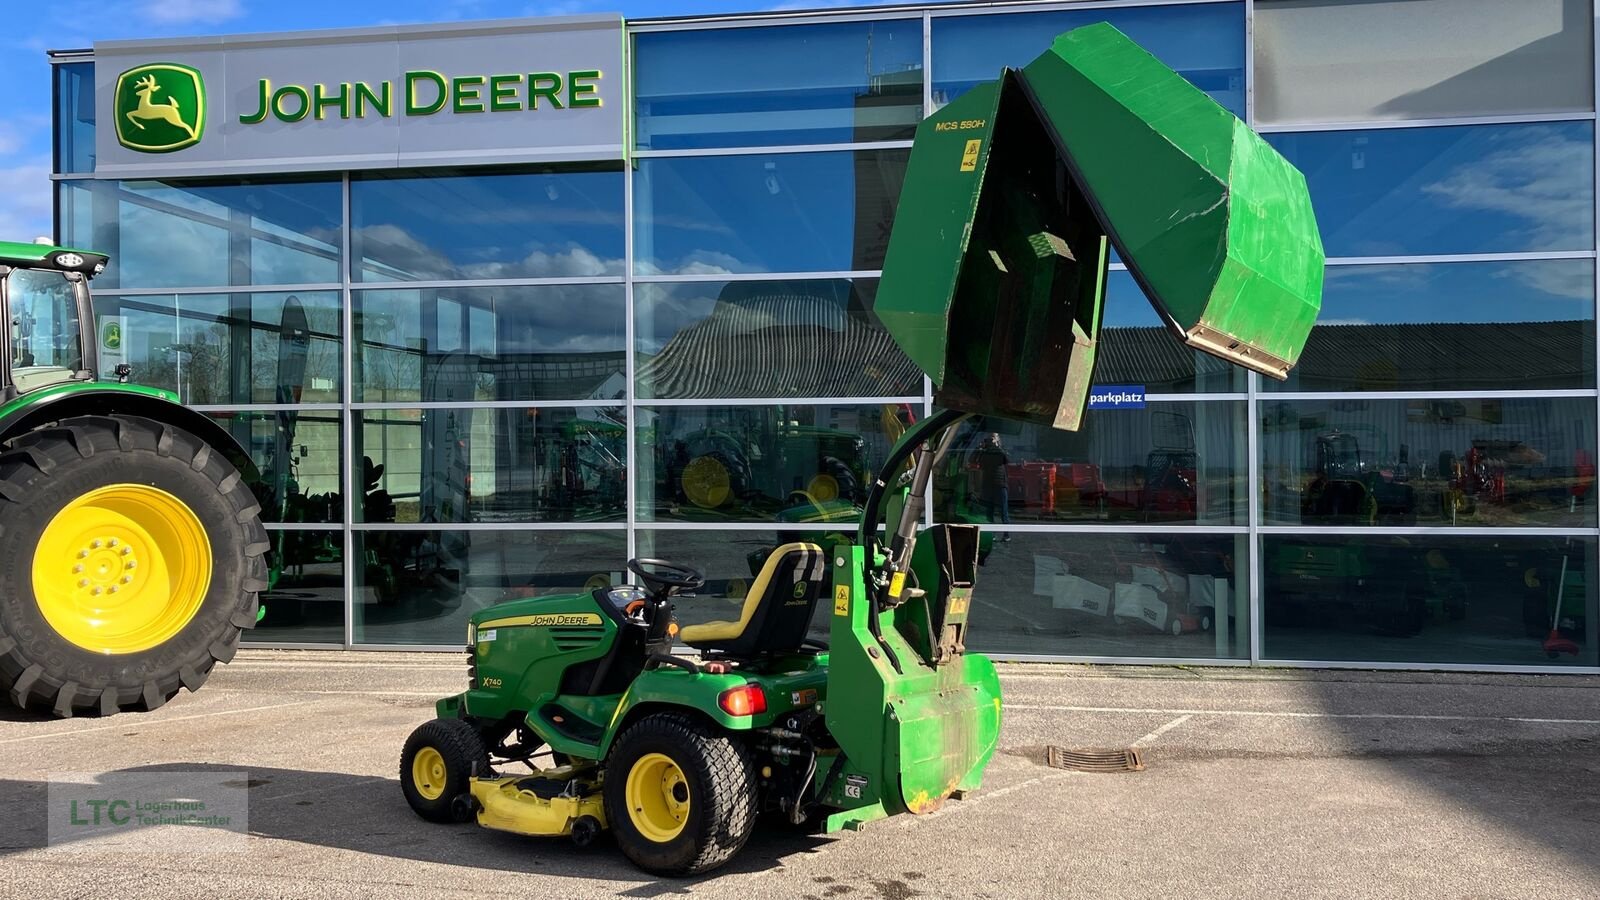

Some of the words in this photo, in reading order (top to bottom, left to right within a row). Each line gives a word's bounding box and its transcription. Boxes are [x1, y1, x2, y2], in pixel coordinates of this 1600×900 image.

[239, 78, 392, 124] JOHN
[405, 70, 602, 117] DEERE
[936, 122, 958, 131] MCS
[1090, 392, 1143, 405] parkplatz
[531, 616, 556, 625] JOHN
[556, 615, 589, 624] DEERE
[483, 676, 502, 687] X740
[847, 786, 859, 797] CE
